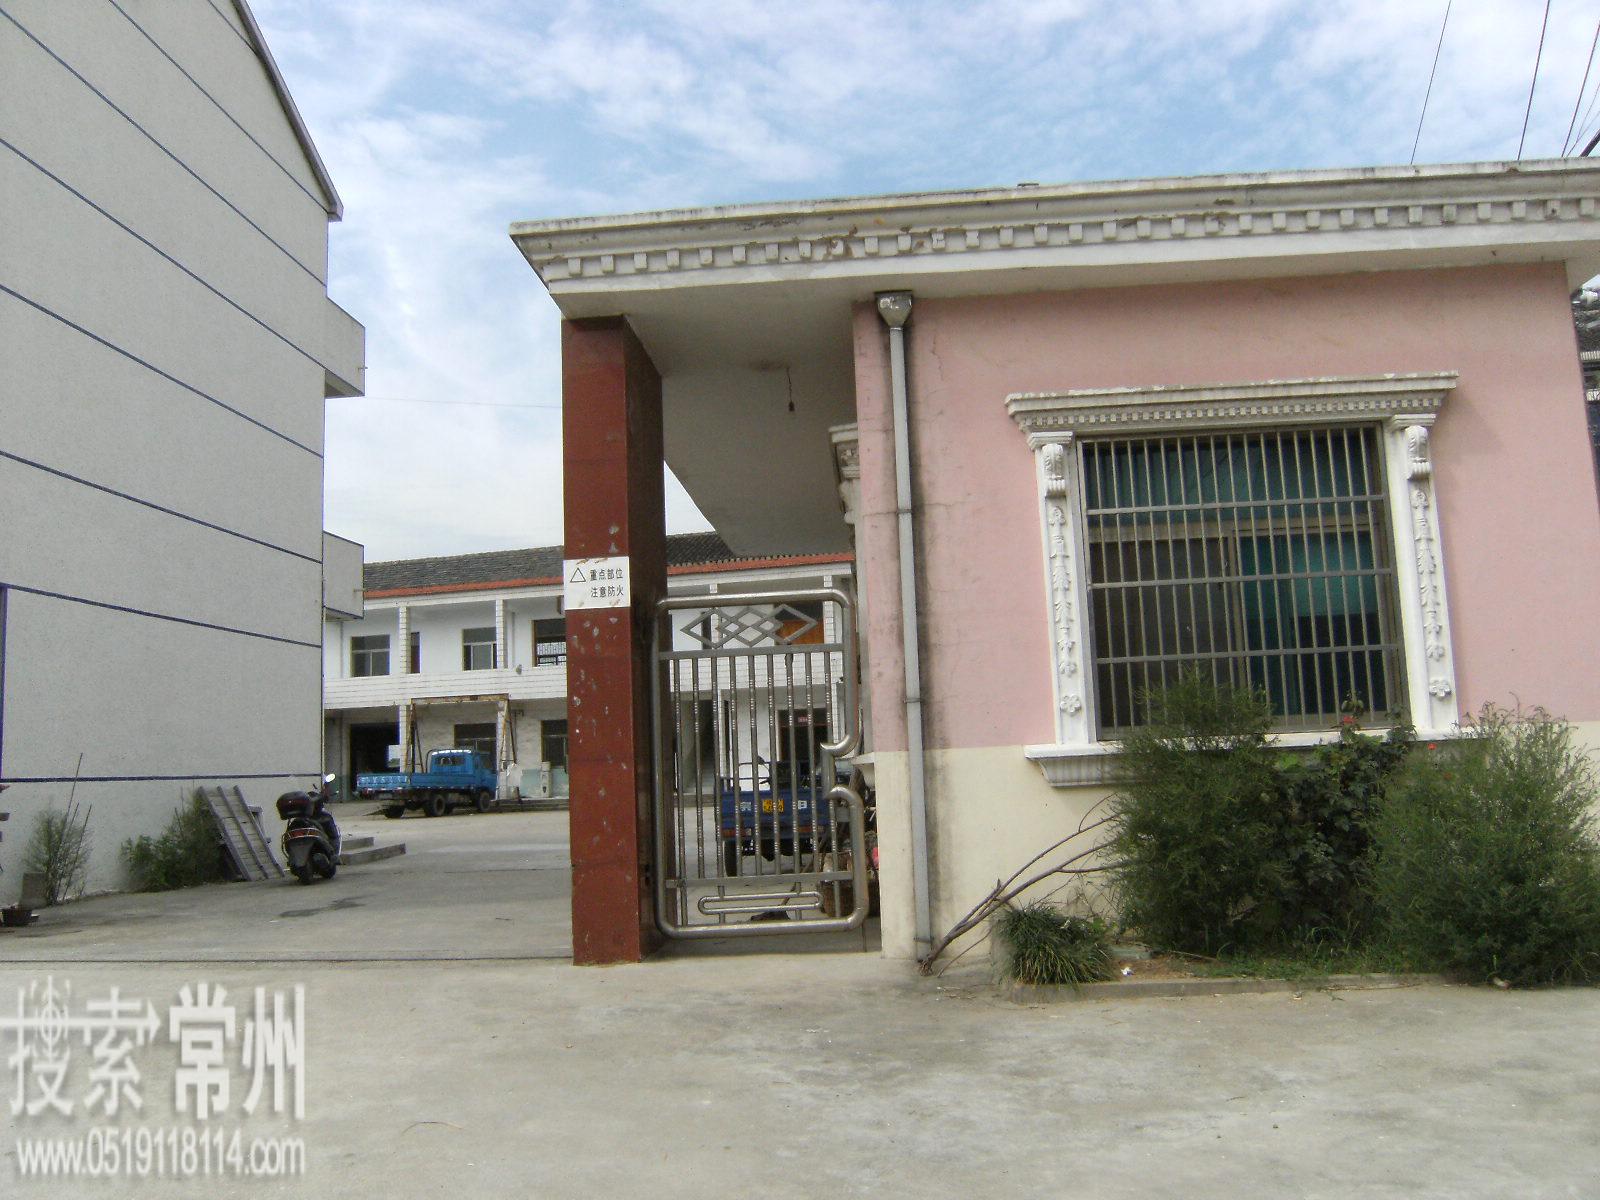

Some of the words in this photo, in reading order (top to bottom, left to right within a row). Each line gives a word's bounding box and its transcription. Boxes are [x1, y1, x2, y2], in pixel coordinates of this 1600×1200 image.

[590, 568, 623, 581] 重点部位
[591, 585, 624, 598] 注意防火
